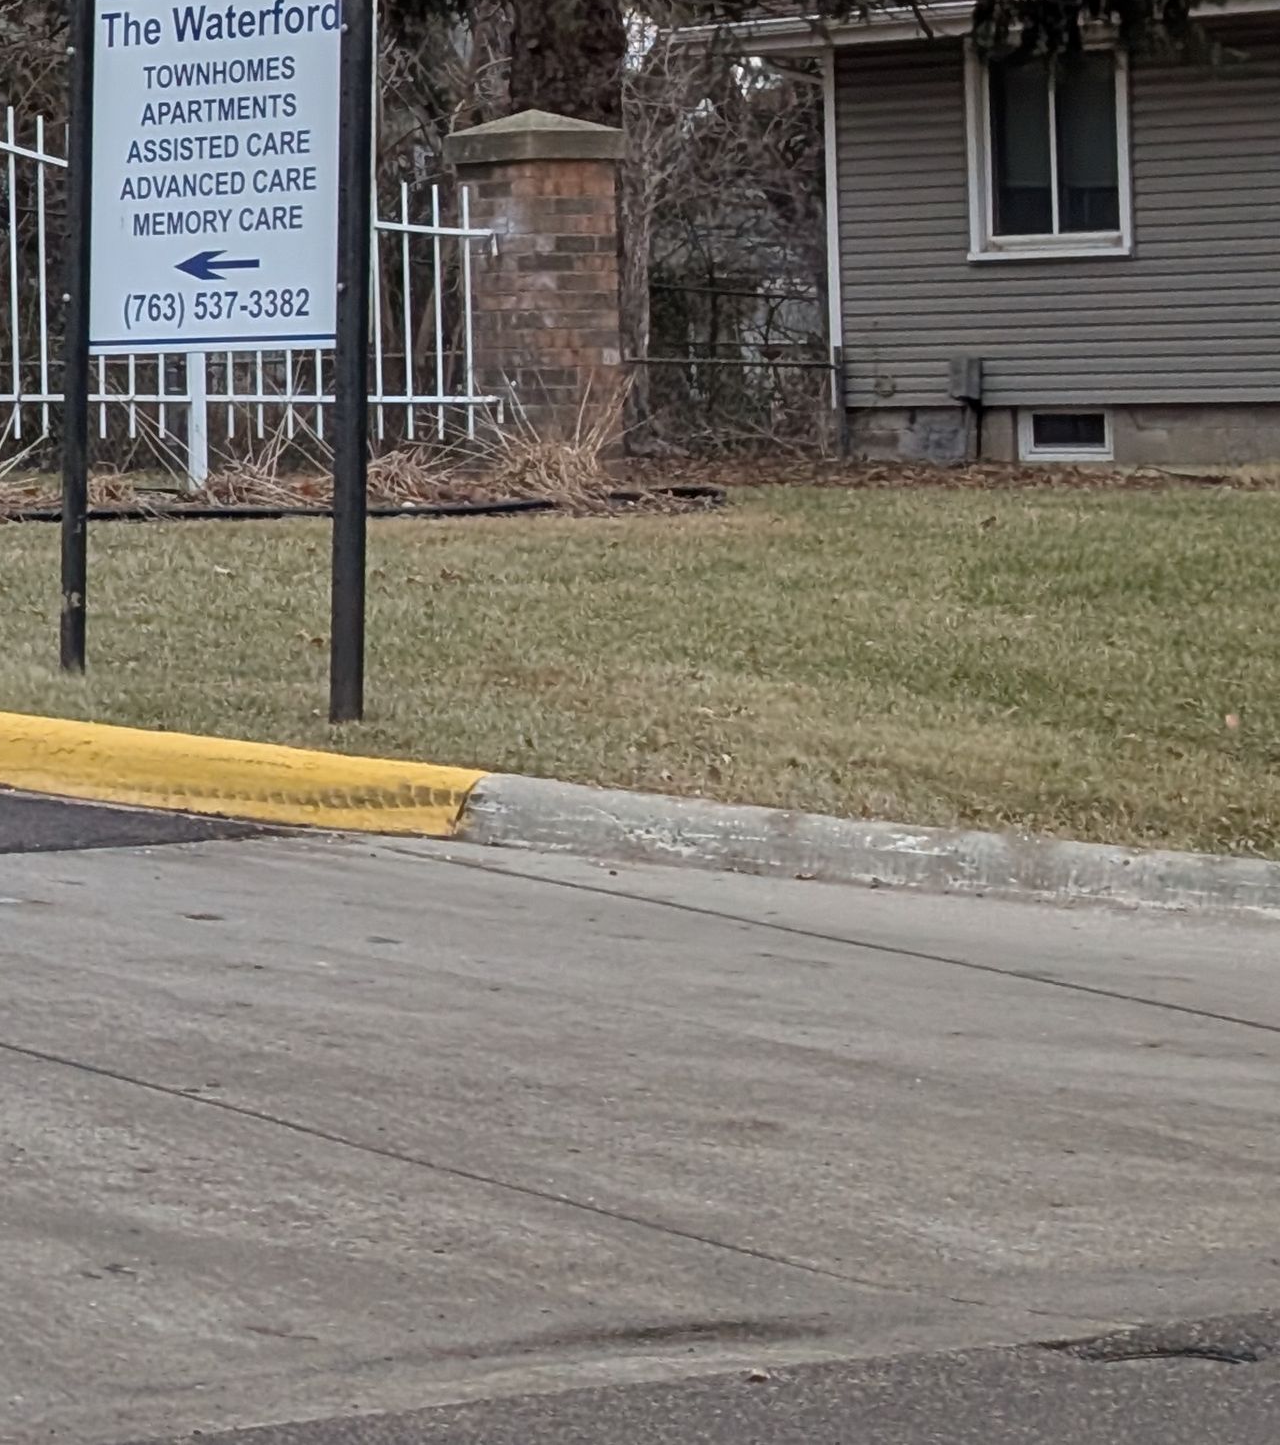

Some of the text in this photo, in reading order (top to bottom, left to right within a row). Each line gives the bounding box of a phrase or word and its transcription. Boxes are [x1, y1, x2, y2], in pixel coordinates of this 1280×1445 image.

[101, 12, 161, 47] The
[143, 56, 295, 89] TOWNHOMES
[141, 93, 297, 127] APARTMENTS
[126, 130, 311, 164] ASSISTED CARE
[120, 167, 317, 201] ADVANCED CARE
[133, 205, 303, 237] MEMORY CARE
[124, 288, 310, 329] (763) 537-3382
